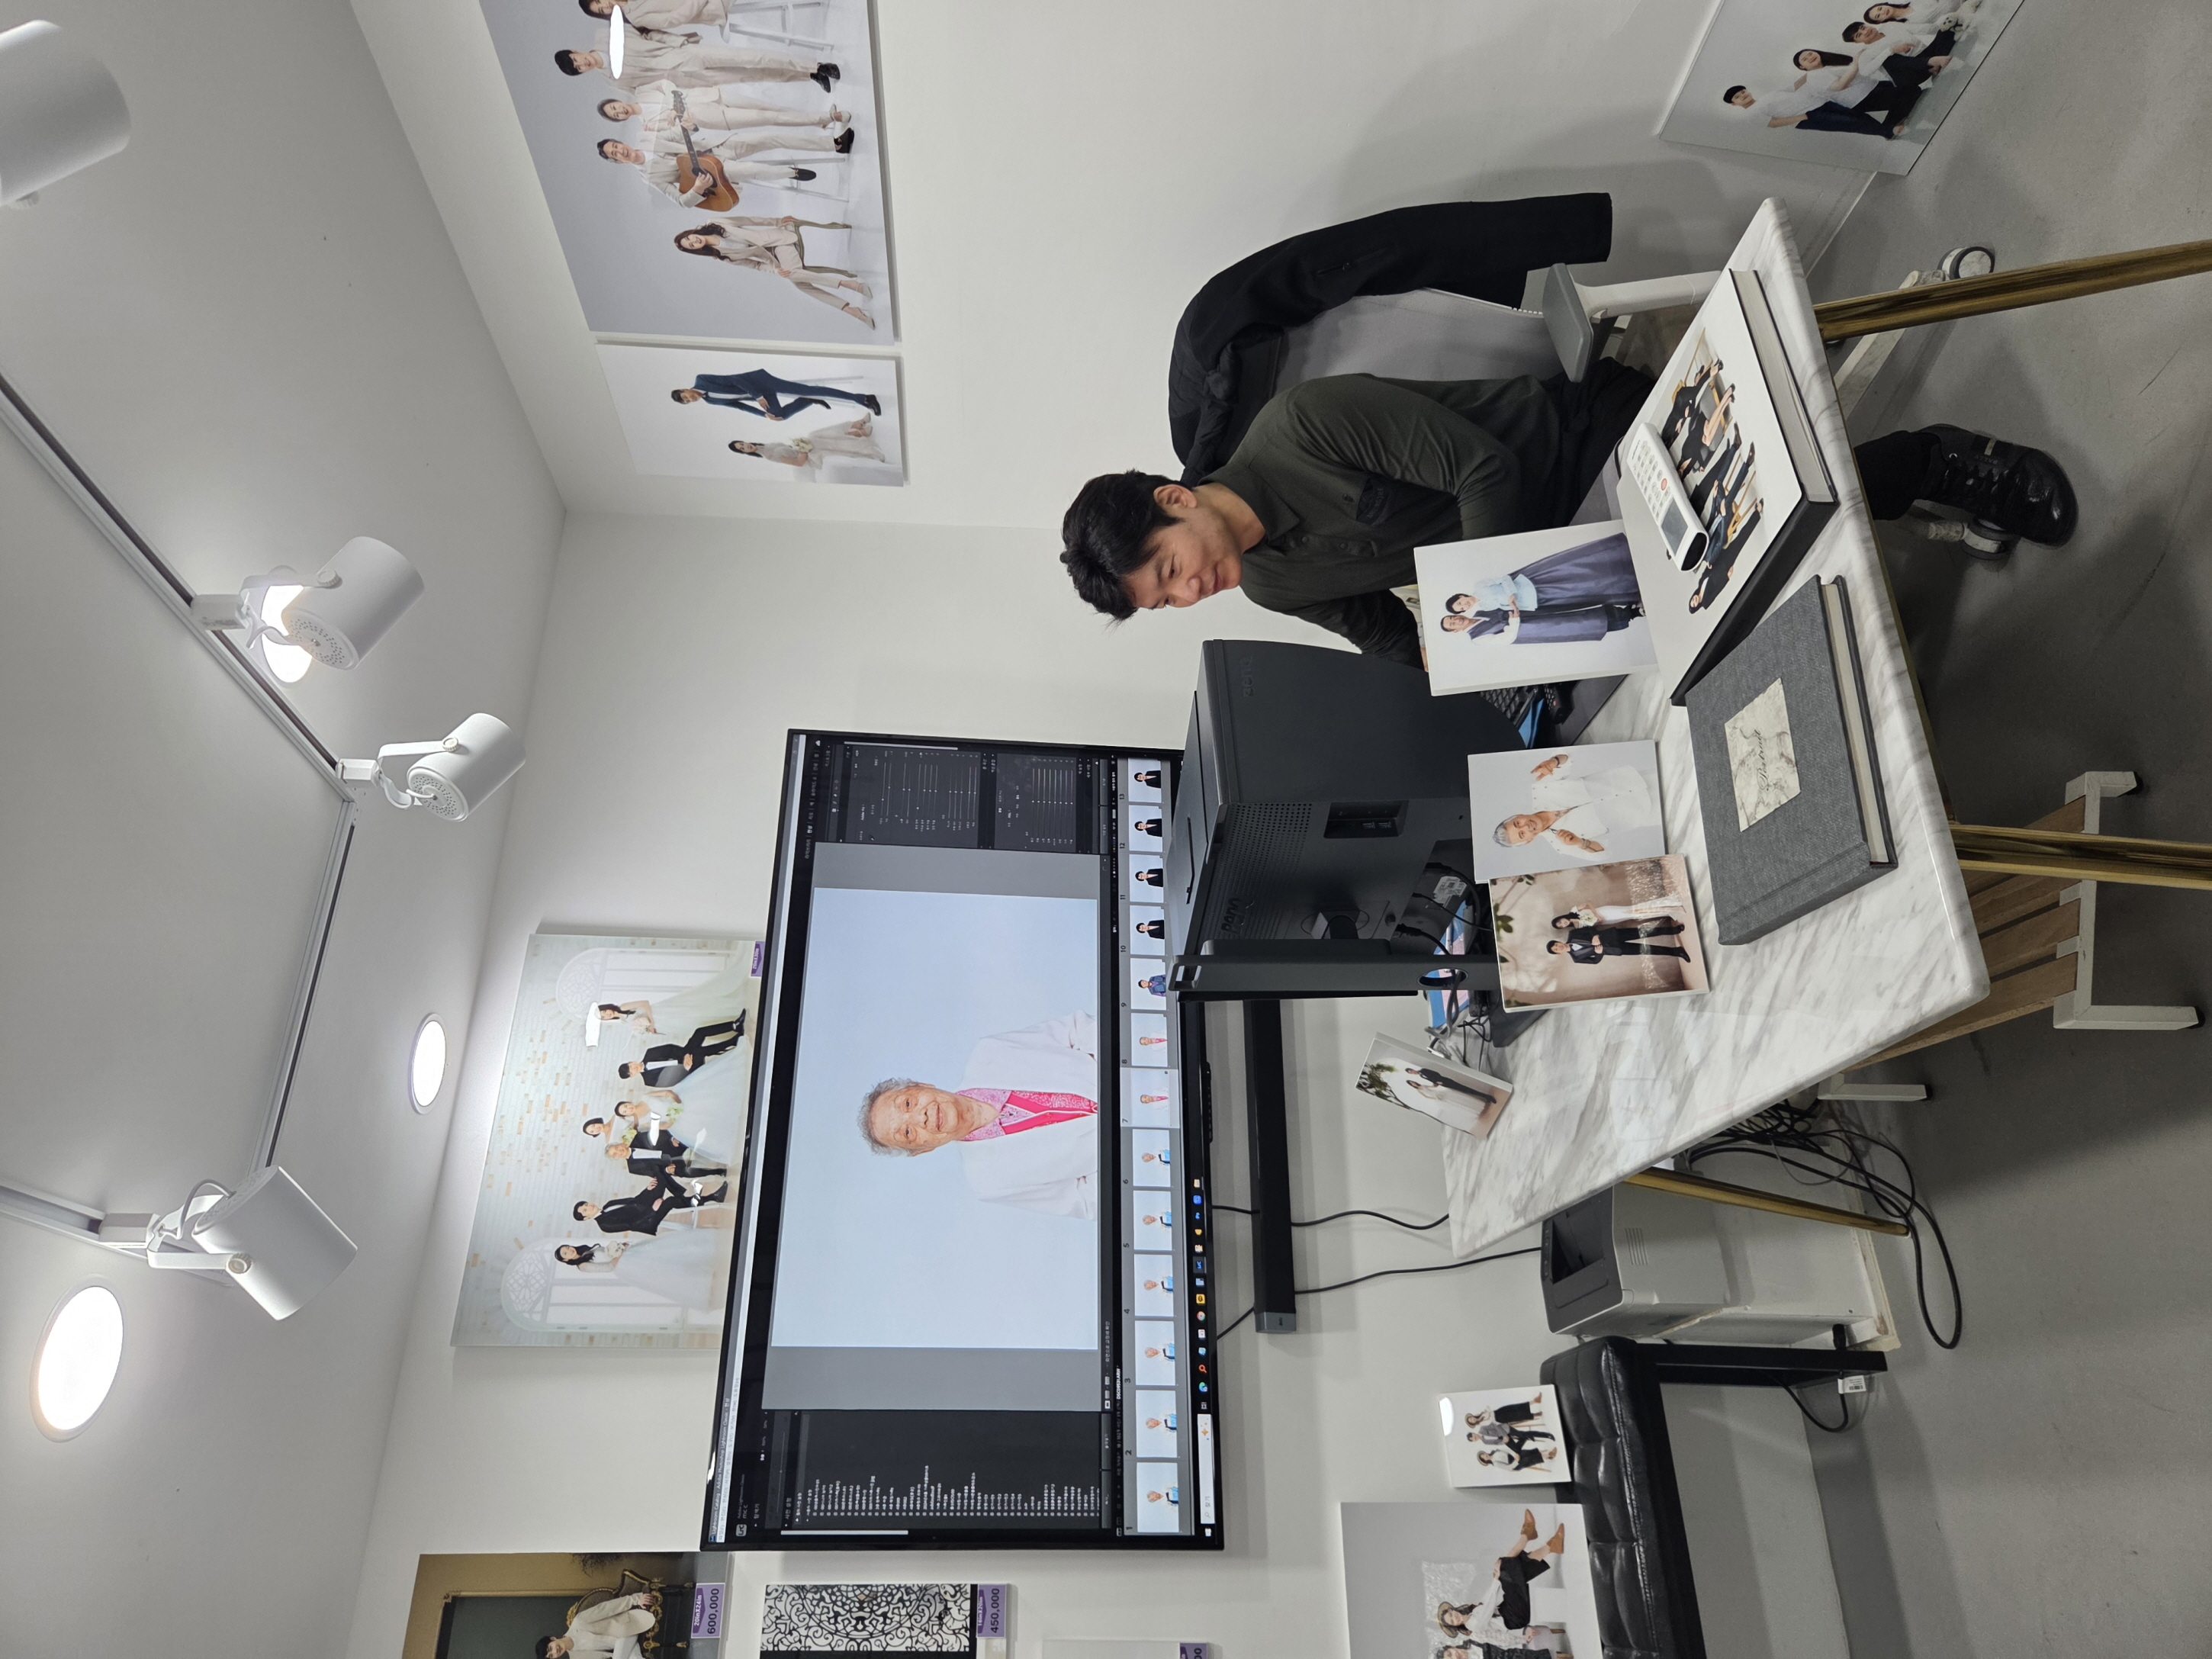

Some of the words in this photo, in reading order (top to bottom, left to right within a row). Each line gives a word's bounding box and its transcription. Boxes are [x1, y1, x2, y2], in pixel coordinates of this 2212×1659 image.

[1239, 655, 1255, 698] BenQ
[1754, 728, 1770, 791] Portrait
[1120, 945, 1127, 953] 10
[707, 1588, 720, 1635] 600,000
[990, 1588, 1001, 1634] 450,000
